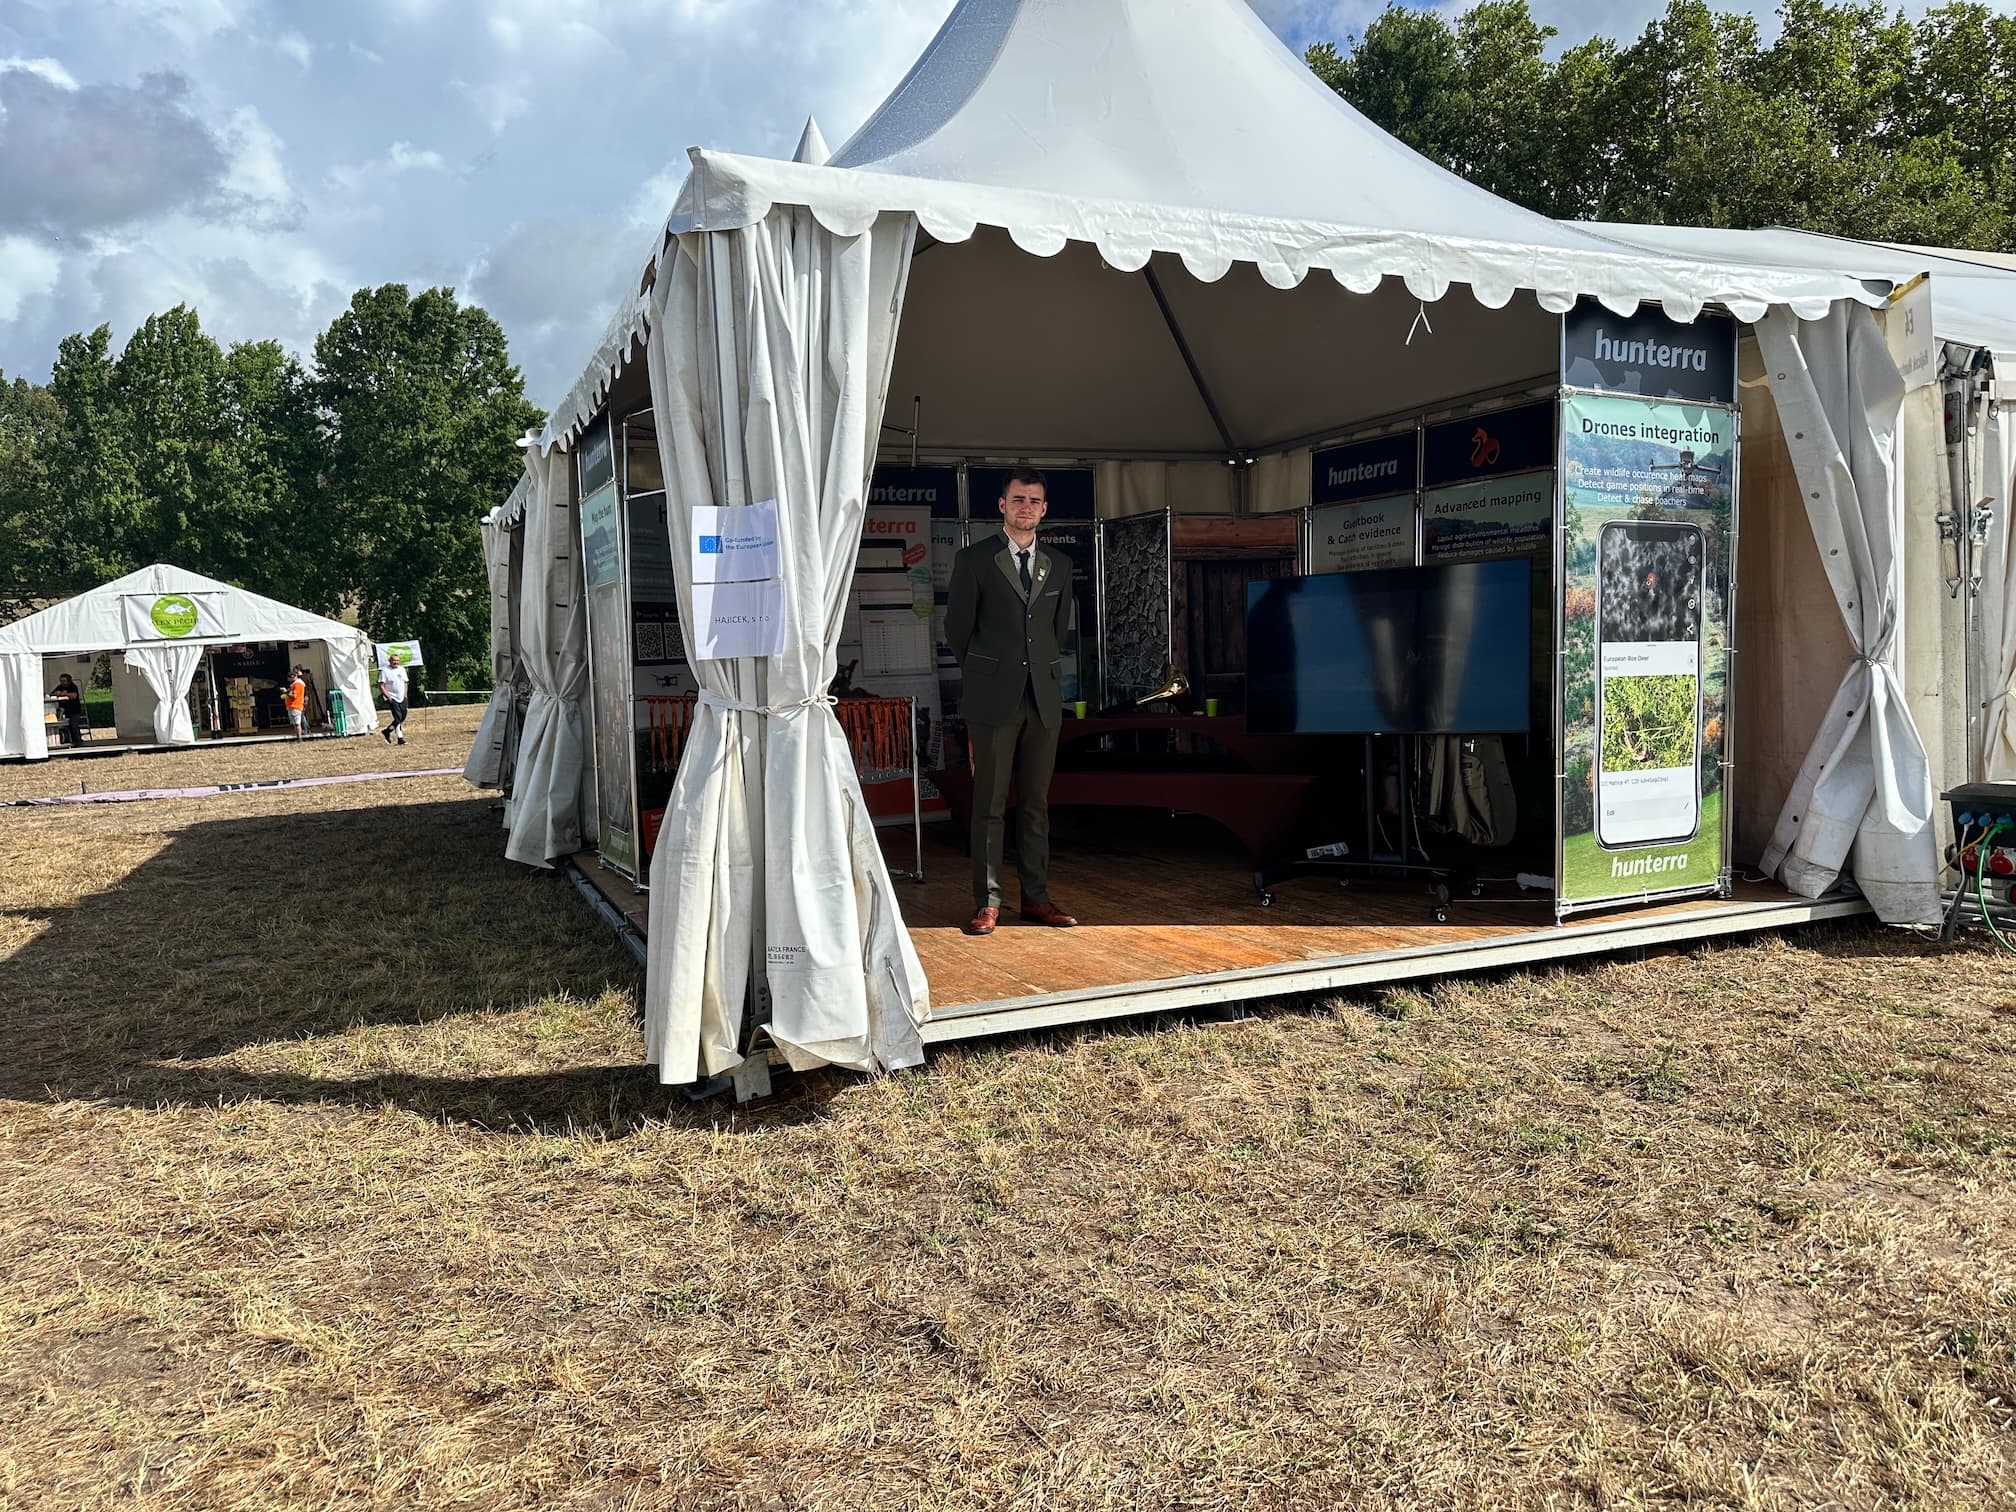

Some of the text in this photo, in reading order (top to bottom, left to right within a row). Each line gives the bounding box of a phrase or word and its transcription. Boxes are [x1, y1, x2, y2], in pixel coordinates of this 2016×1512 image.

[1594, 328, 1707, 372] hunterra
[1582, 418, 1720, 444] Drones integration
[1328, 458, 1398, 487] hunterra
[1574, 466, 1602, 476] Create
[1603, 468, 1630, 478] wildlife
[872, 485, 937, 502] nterra
[1578, 479, 1604, 489] Detect
[1606, 481, 1628, 491] game
[1629, 482, 1662, 493] positions
[1434, 491, 1542, 515] Advanced mapping
[1597, 492, 1623, 503] Detect
[1632, 495, 1654, 505] chase
[1655, 496, 1688, 507] poachers
[864, 519, 917, 534] terra
[1328, 535, 1336, 545] &
[1359, 526, 1401, 541] evidence
[1040, 534, 1077, 543] events
[1611, 853, 1688, 878] hunterra
